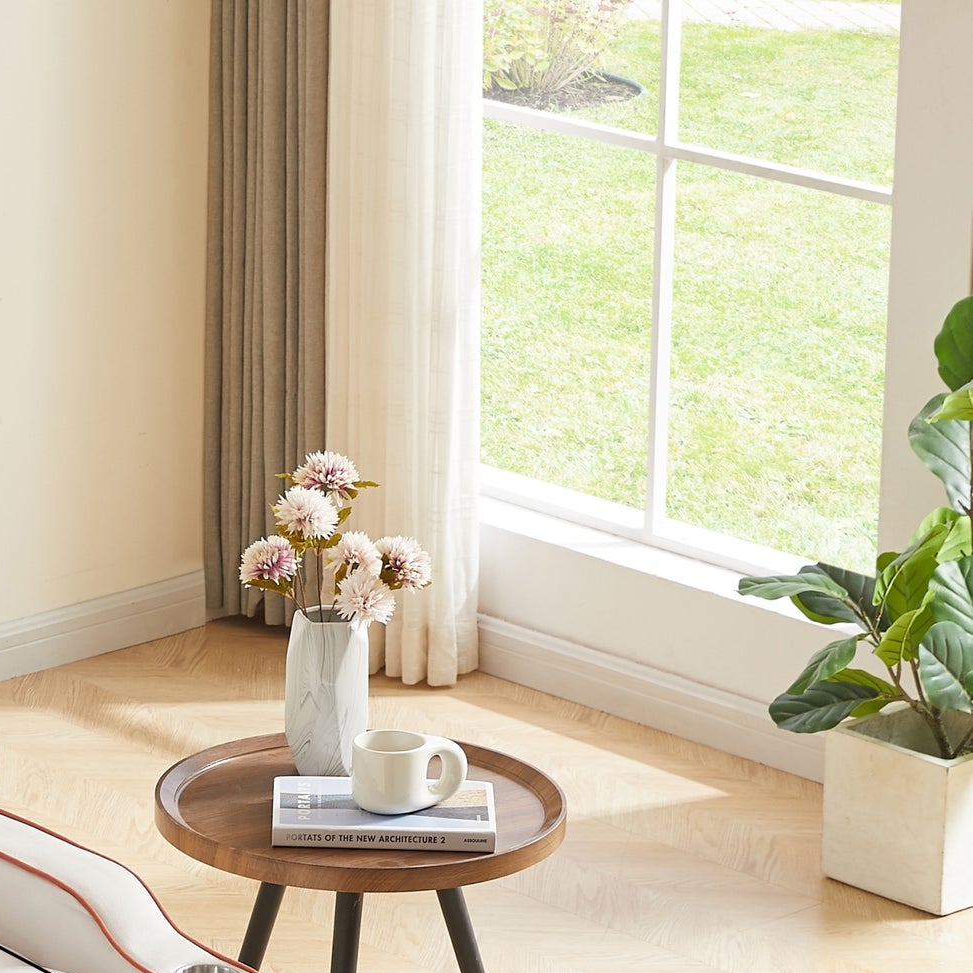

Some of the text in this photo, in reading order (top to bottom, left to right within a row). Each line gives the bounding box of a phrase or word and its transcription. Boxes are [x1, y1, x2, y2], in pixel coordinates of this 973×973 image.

[286, 833, 446, 844] PORTATS OF THE NEW ARCHITECTURE 2
